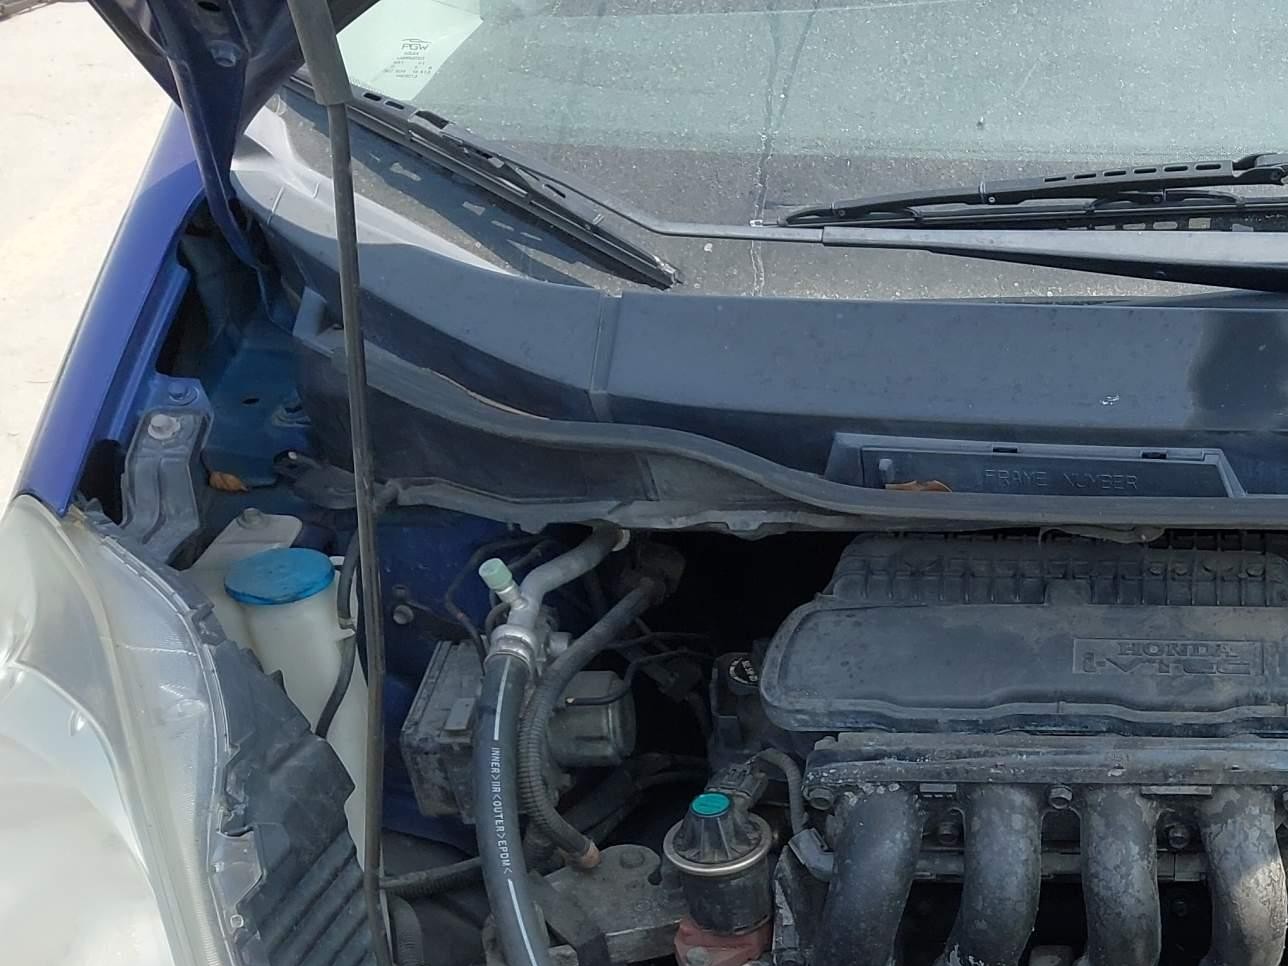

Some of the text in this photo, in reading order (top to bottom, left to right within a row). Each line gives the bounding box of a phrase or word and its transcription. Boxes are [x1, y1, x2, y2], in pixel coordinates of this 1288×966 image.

[984, 469, 1138, 489] FRAME NUMBER
[1118, 642, 1240, 658] HONDA
